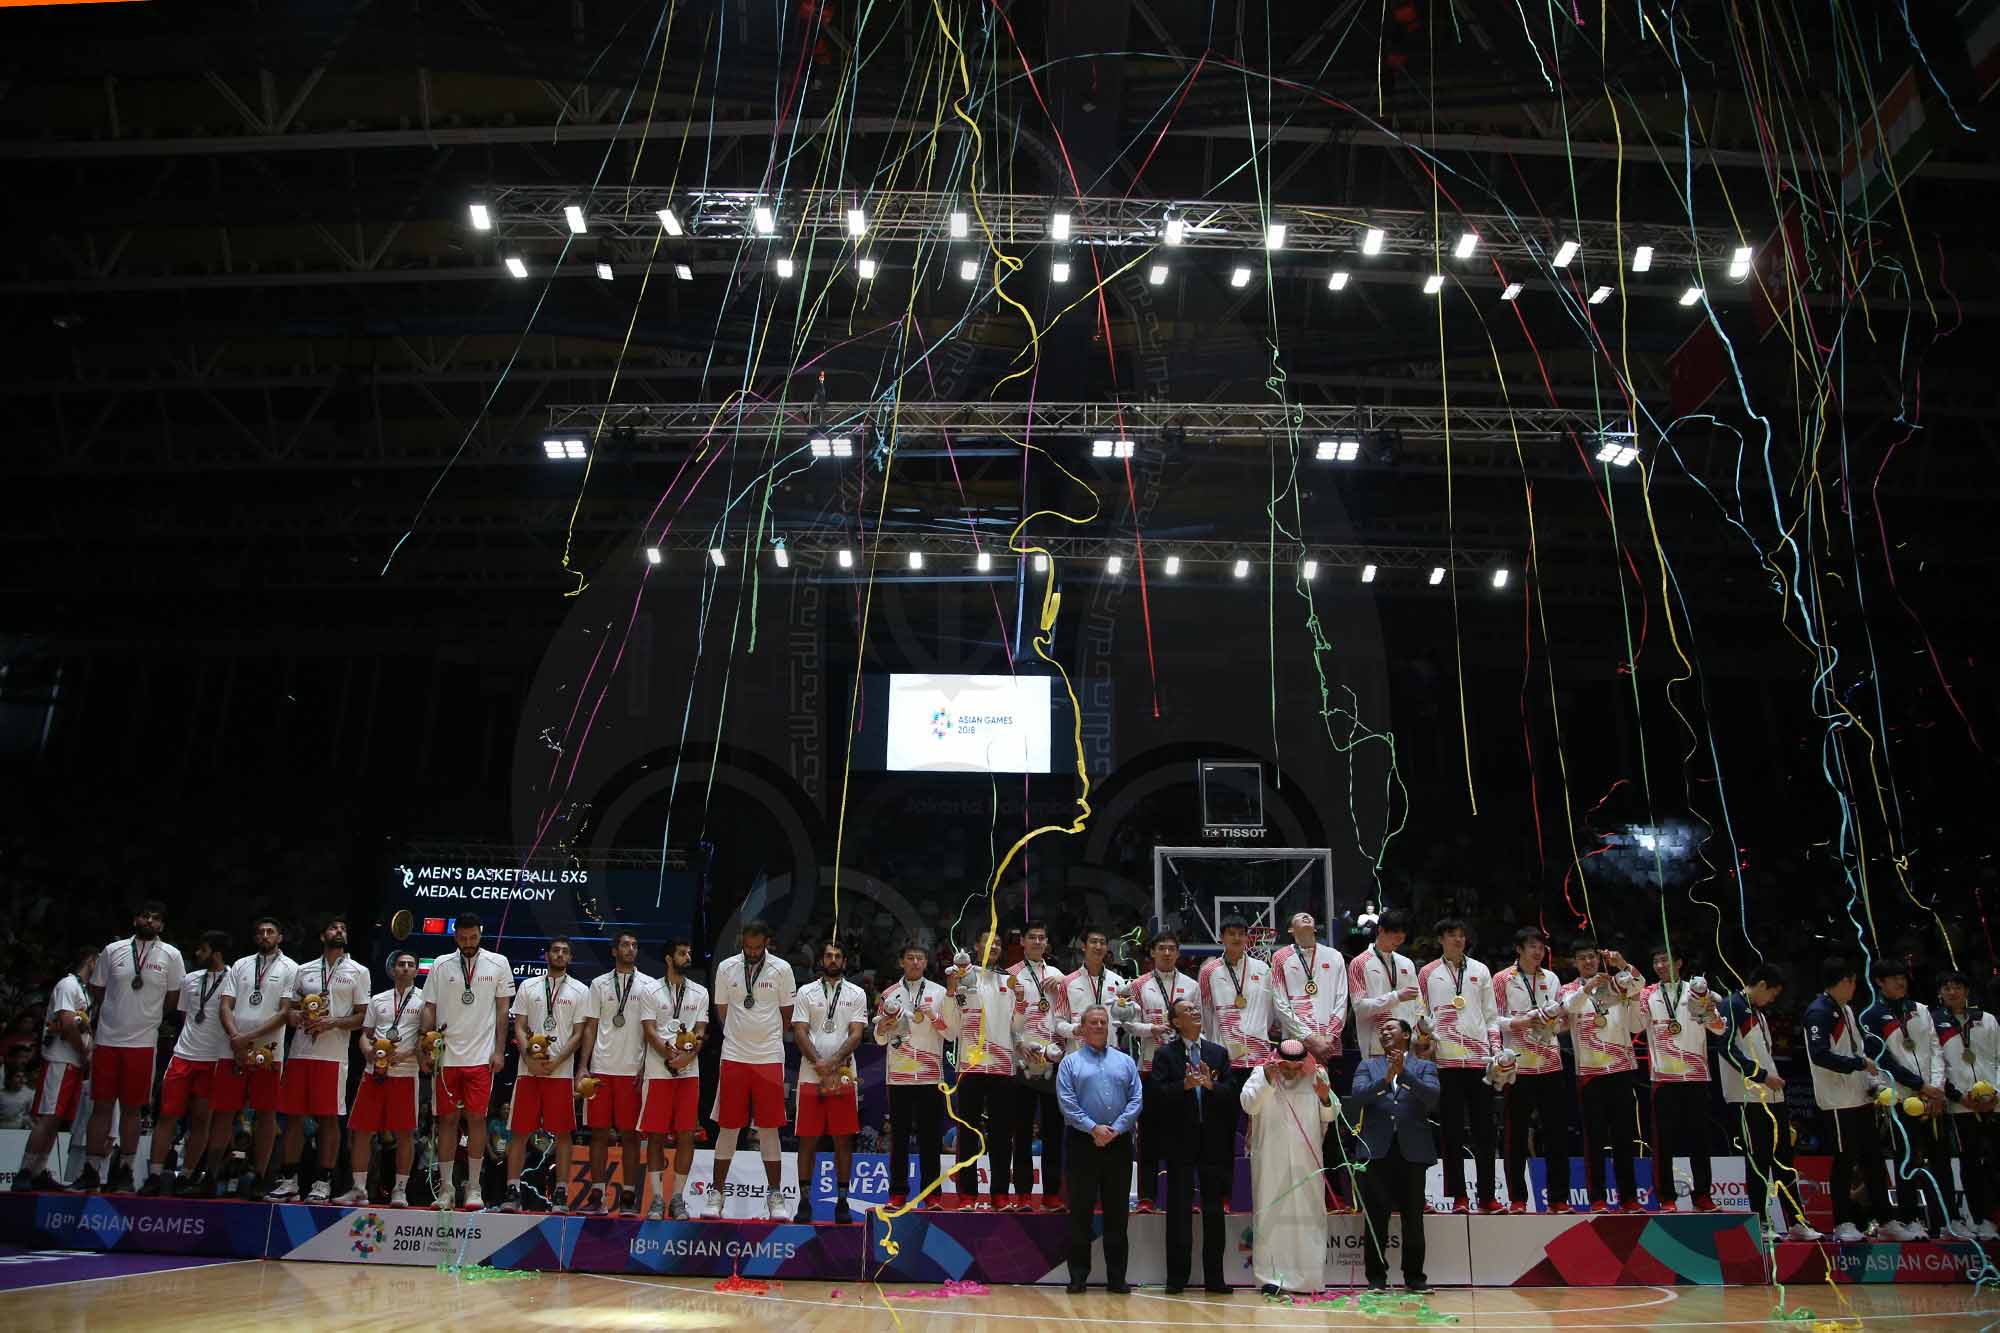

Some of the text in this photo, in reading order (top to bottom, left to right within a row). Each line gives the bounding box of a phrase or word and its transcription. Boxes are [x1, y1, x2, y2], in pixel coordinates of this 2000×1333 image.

[958, 716, 1013, 725] ASIAN GAMES
[1221, 828, 1268, 838] TISSOT
[418, 867, 588, 883] MEN'S BASKETBALL 5X5
[416, 885, 556, 901] MEDAL CEREMONY
[513, 965, 525, 976] of
[821, 1160, 915, 1178] PCAI
[45, 1211, 205, 1235] 18th ASIAN GAMES
[394, 1226, 482, 1239] ASIAN GAMES
[393, 1239, 421, 1251] 2018
[629, 1238, 796, 1259] 18th ASIAN GAMES
[1865, 1255, 1921, 1271] ASIAN
[1925, 1255, 1992, 1271] GAMES
